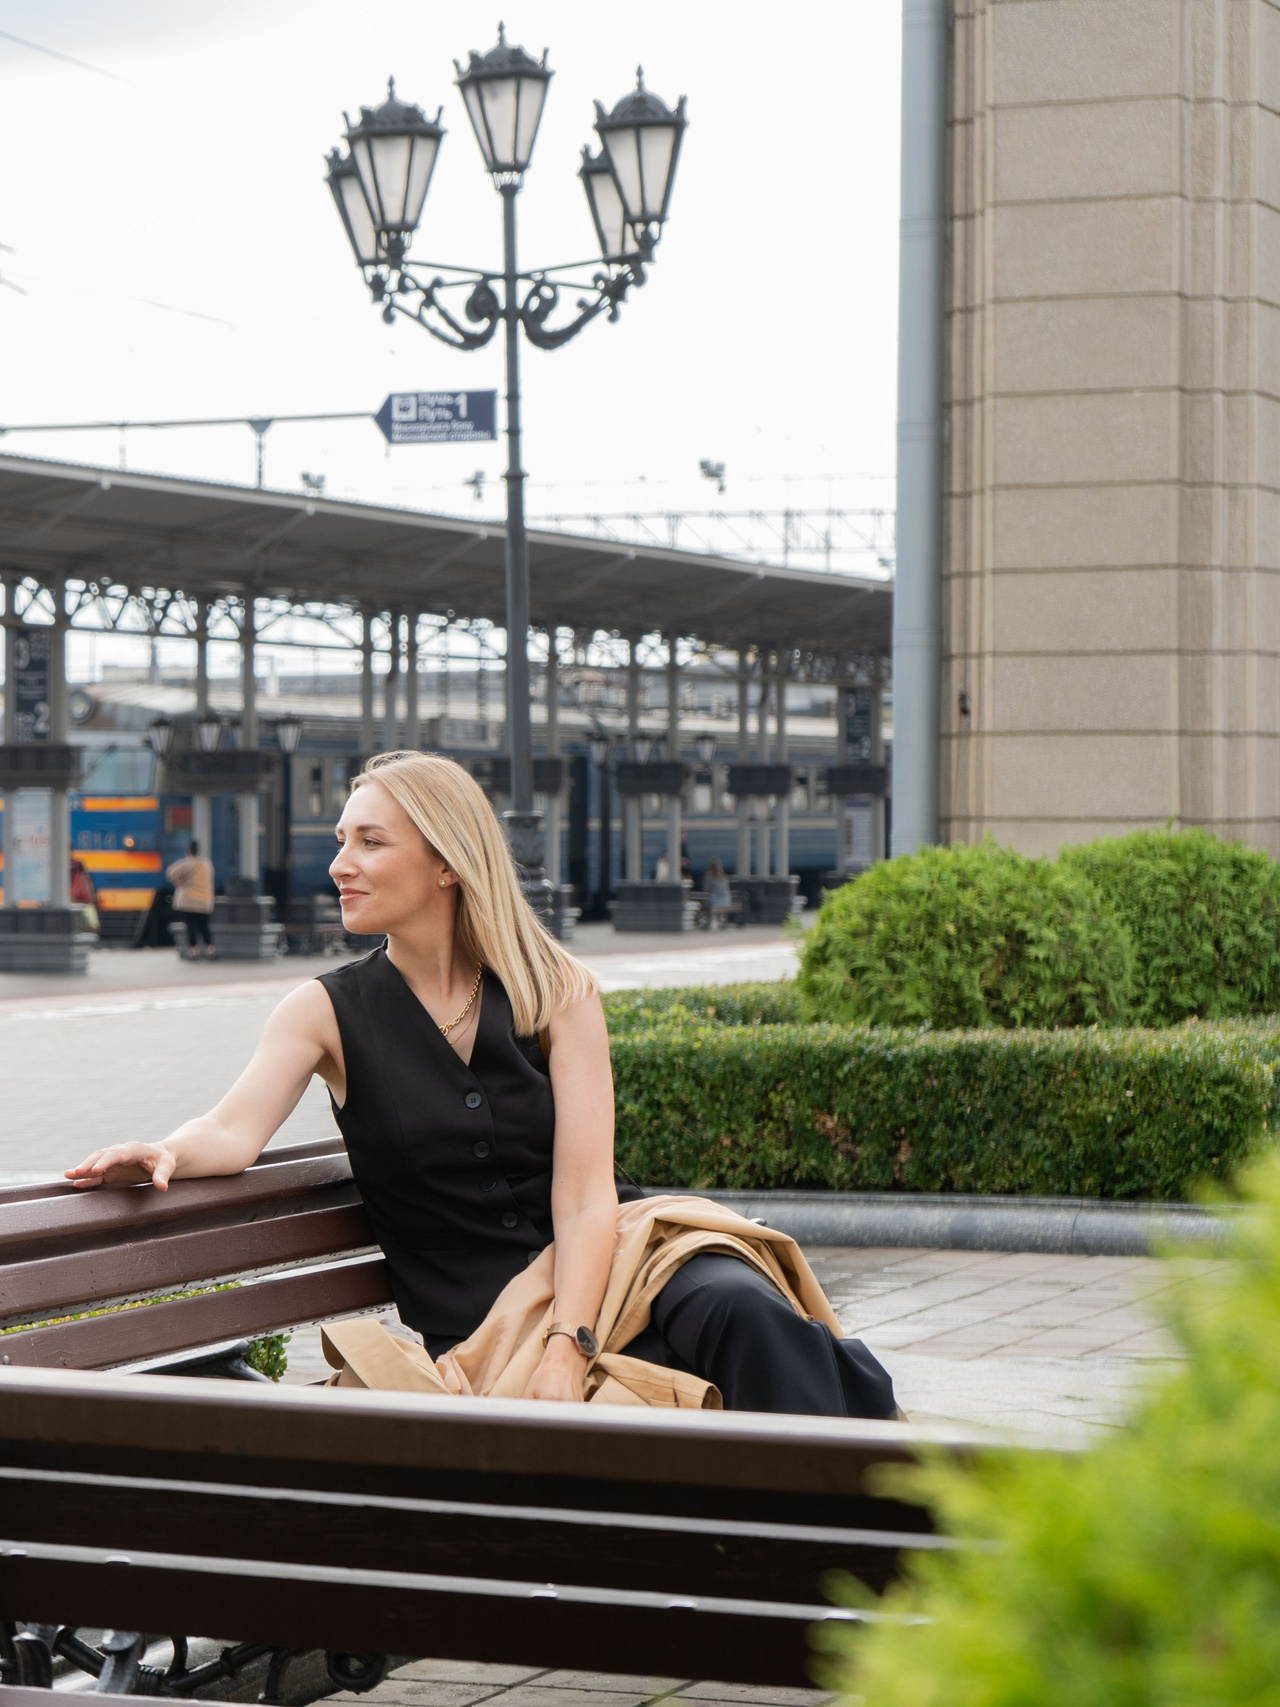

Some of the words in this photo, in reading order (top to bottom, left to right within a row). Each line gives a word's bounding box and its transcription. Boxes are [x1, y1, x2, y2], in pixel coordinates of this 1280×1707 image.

[418, 405, 453, 423] Путь
[455, 392, 467, 419] 1
[15, 638, 30, 670] 3
[34, 701, 50, 733] 2
